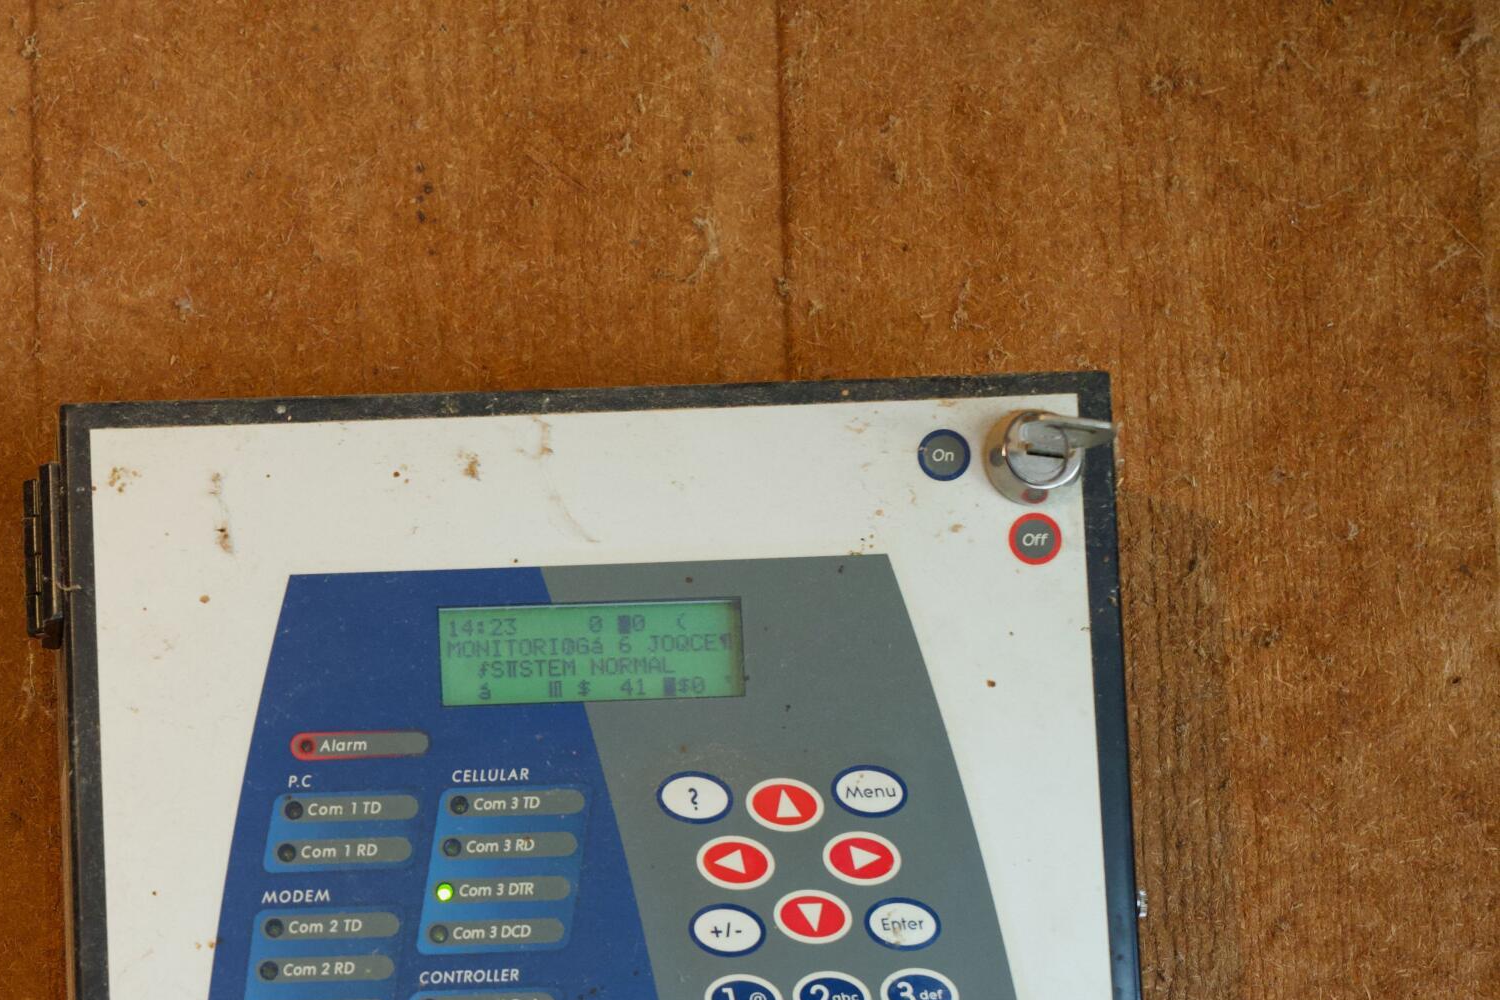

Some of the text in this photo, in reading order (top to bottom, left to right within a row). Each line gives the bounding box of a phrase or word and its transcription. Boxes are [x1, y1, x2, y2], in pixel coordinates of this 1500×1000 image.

[932, 448, 954, 462] On
[1022, 533, 1049, 547] Off
[450, 618, 517, 637] 14:23
[590, 656, 676, 676] NORMAL
[319, 737, 368, 753] Alarm
[451, 768, 531, 784] CELLULAR
[688, 787, 699, 811] ?
[845, 784, 897, 799] Menu
[307, 800, 383, 817] Com 1 TD
[473, 795, 541, 812] Com 3 TD
[300, 843, 378, 859] Com 1 RD
[466, 838, 536, 854] Com 3 RD
[261, 889, 331, 904] MODEM
[459, 882, 535, 898] Com 3 DTR
[288, 918, 363, 935] Com 2 TD
[452, 924, 532, 941] Com 3 DCD
[881, 917, 925, 932] Enter
[282, 961, 356, 978] Com 2 RD
[418, 968, 520, 985] CONTROLLER
